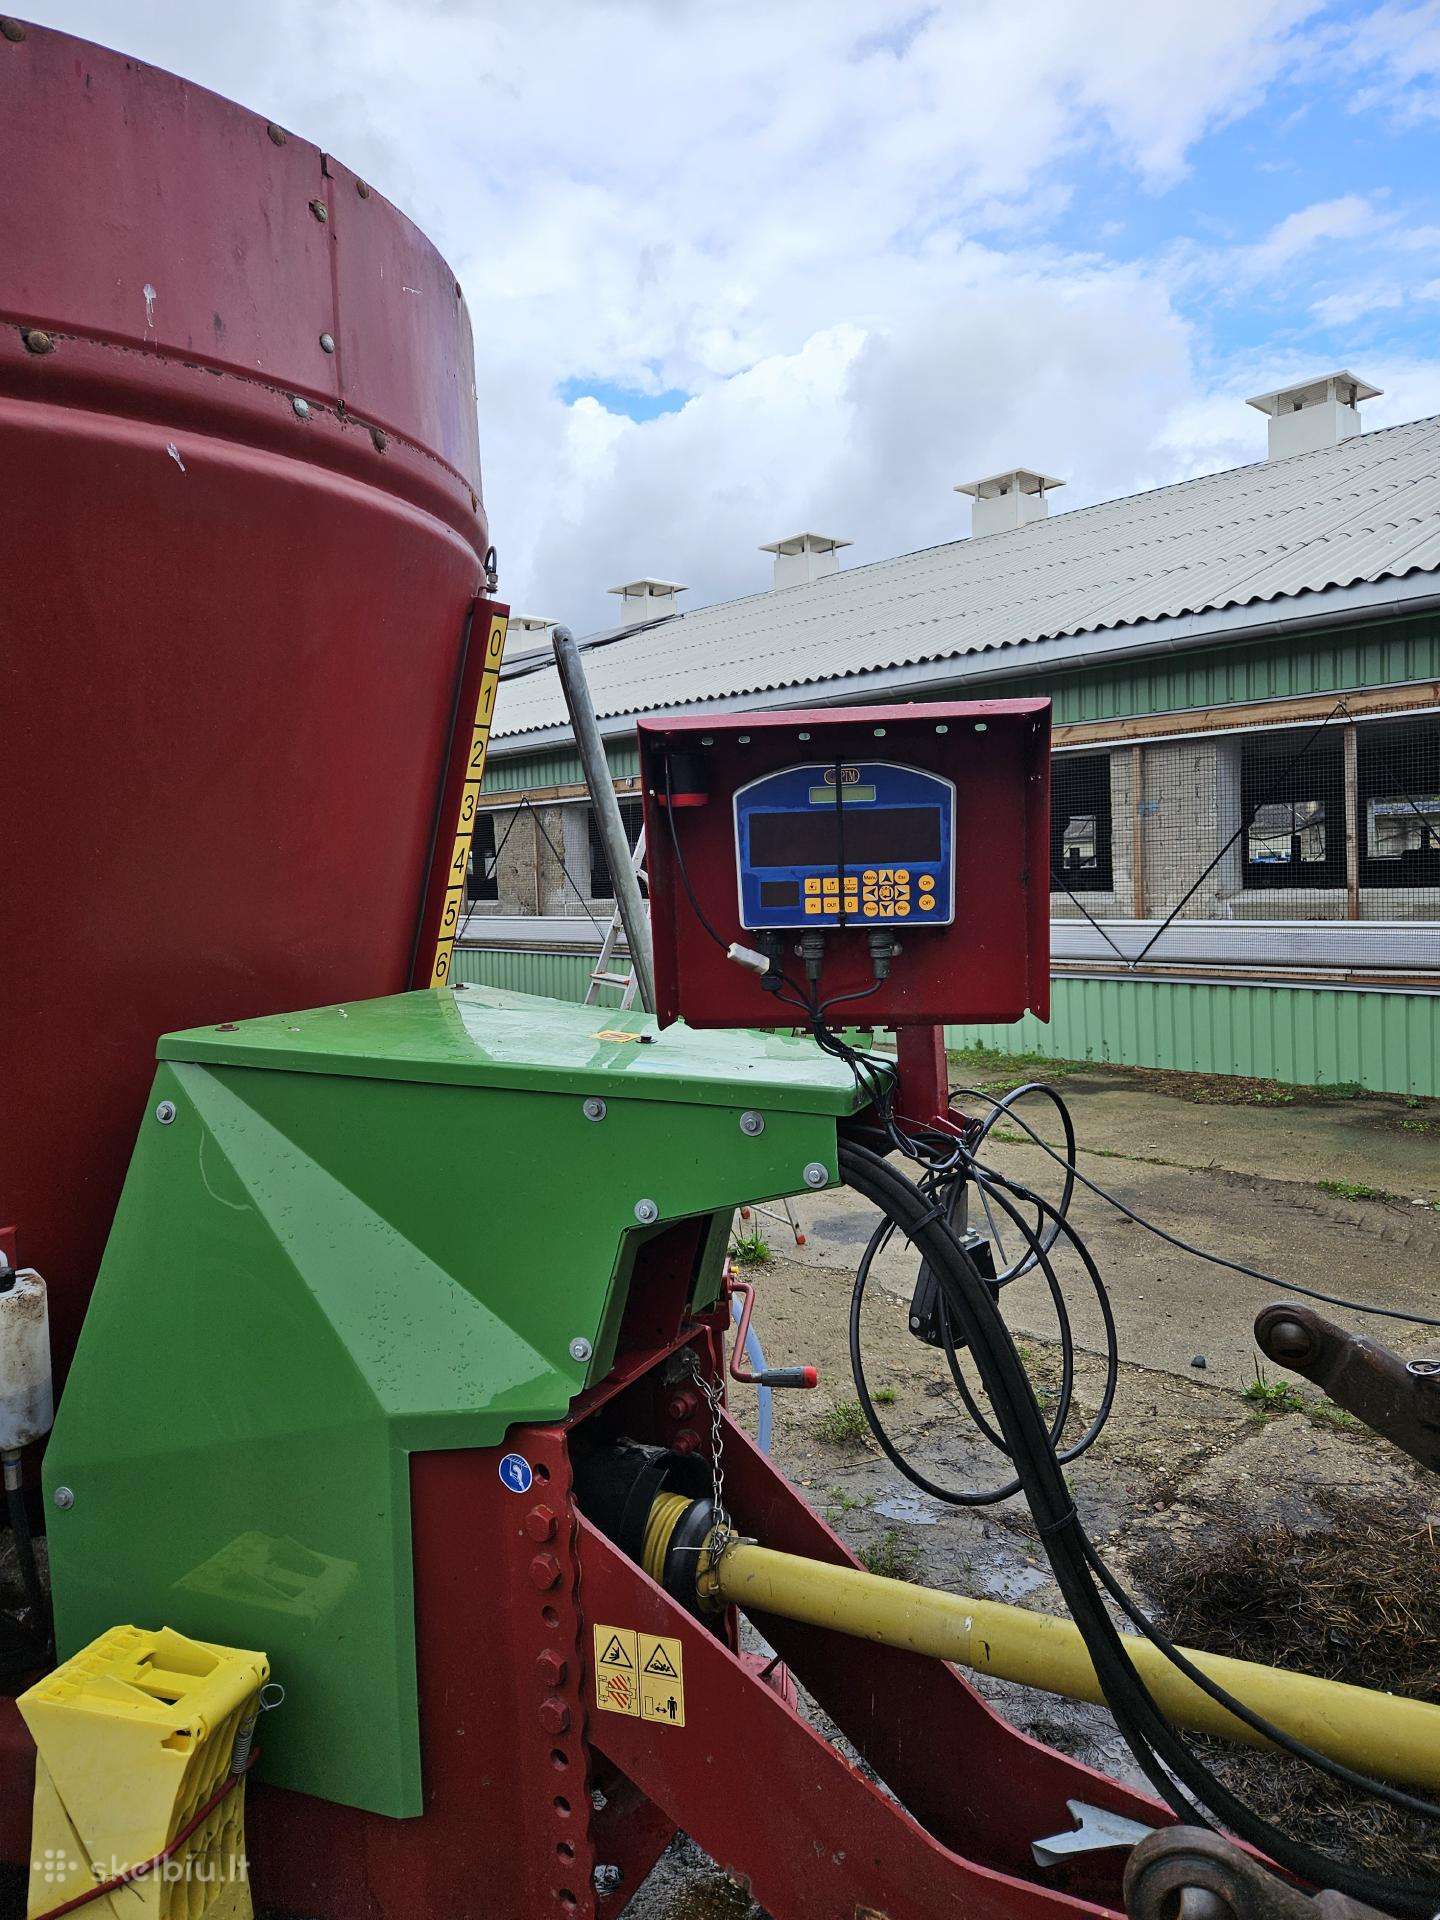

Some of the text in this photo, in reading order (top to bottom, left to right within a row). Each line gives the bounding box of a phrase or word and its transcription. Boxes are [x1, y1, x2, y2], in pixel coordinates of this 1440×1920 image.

[490, 629, 502, 657] 0
[484, 686, 492, 714] 1
[470, 741, 484, 767] 2
[461, 795, 475, 821] 3
[453, 848, 465, 874] 4
[444, 901, 458, 926] 5
[435, 952, 448, 977] 6
